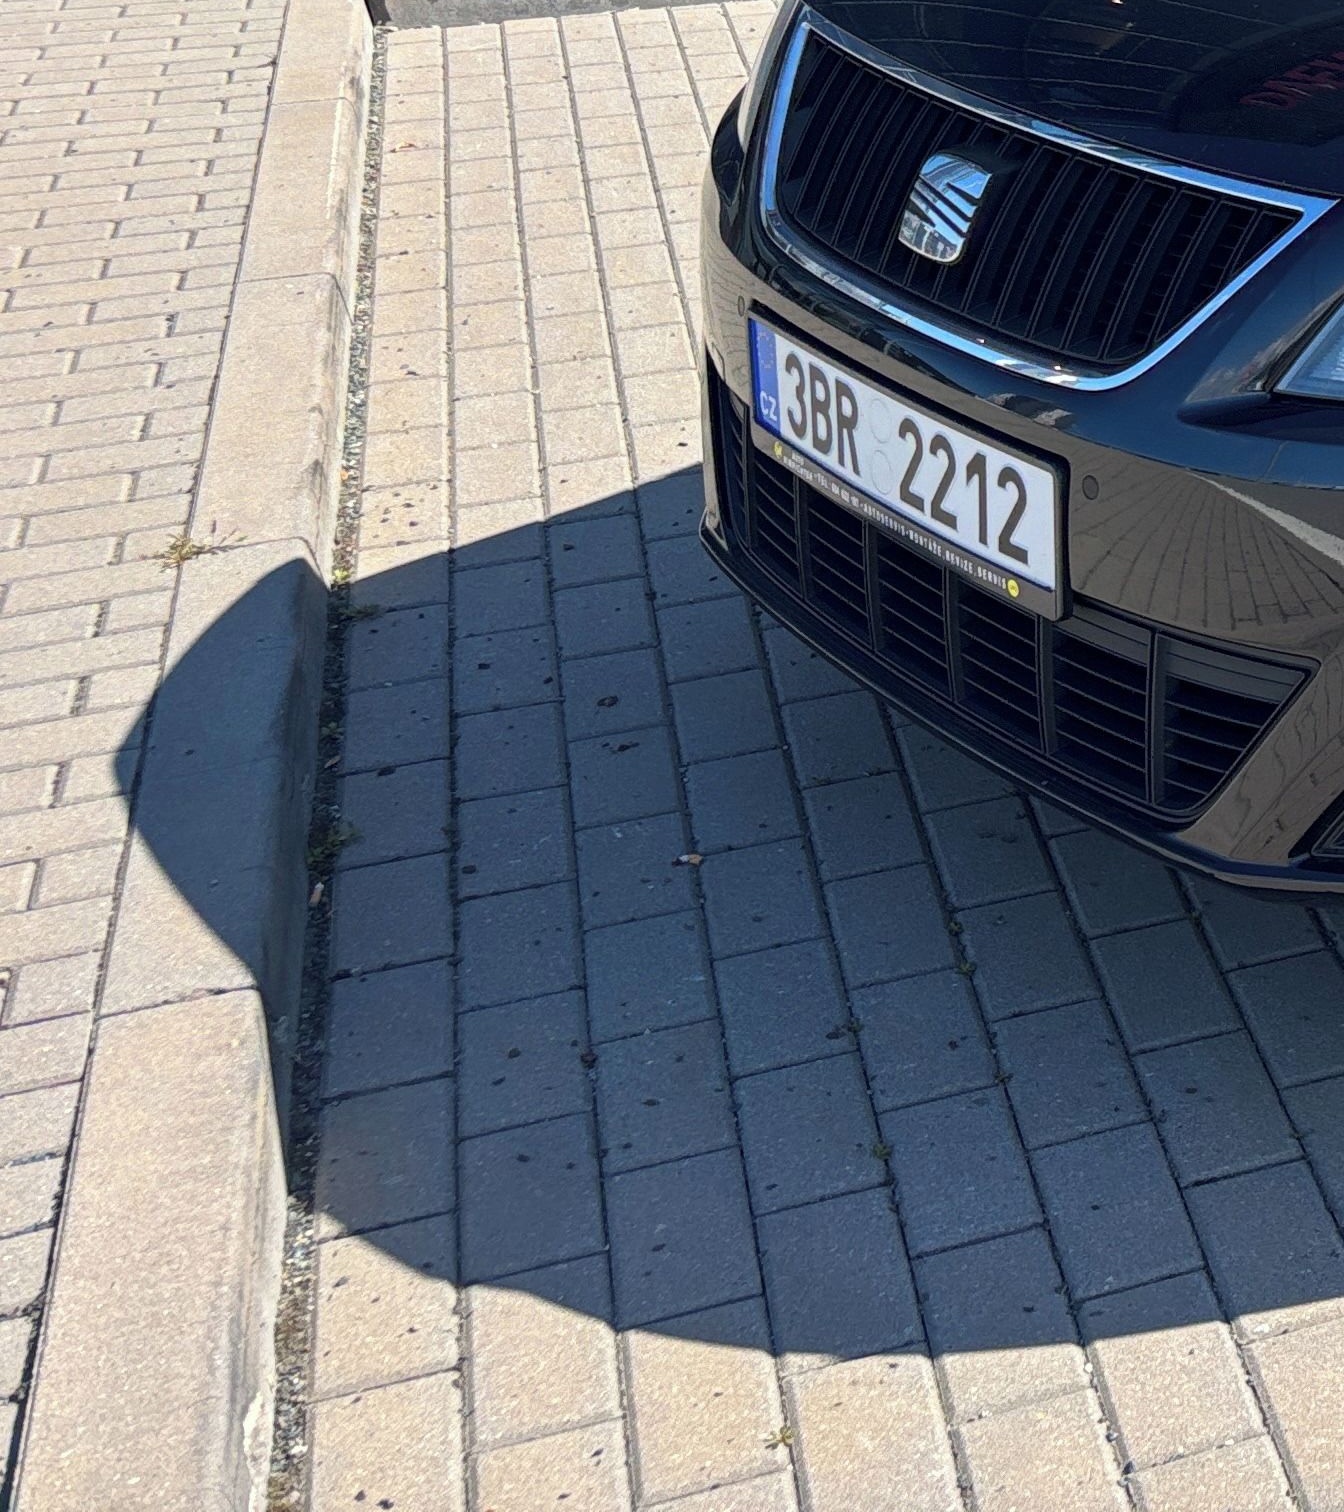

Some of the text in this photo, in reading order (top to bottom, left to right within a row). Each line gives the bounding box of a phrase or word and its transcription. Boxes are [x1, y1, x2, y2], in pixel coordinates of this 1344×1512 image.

[760, 391, 778, 422] CZ
[784, 354, 1029, 565] 3BR 2212
